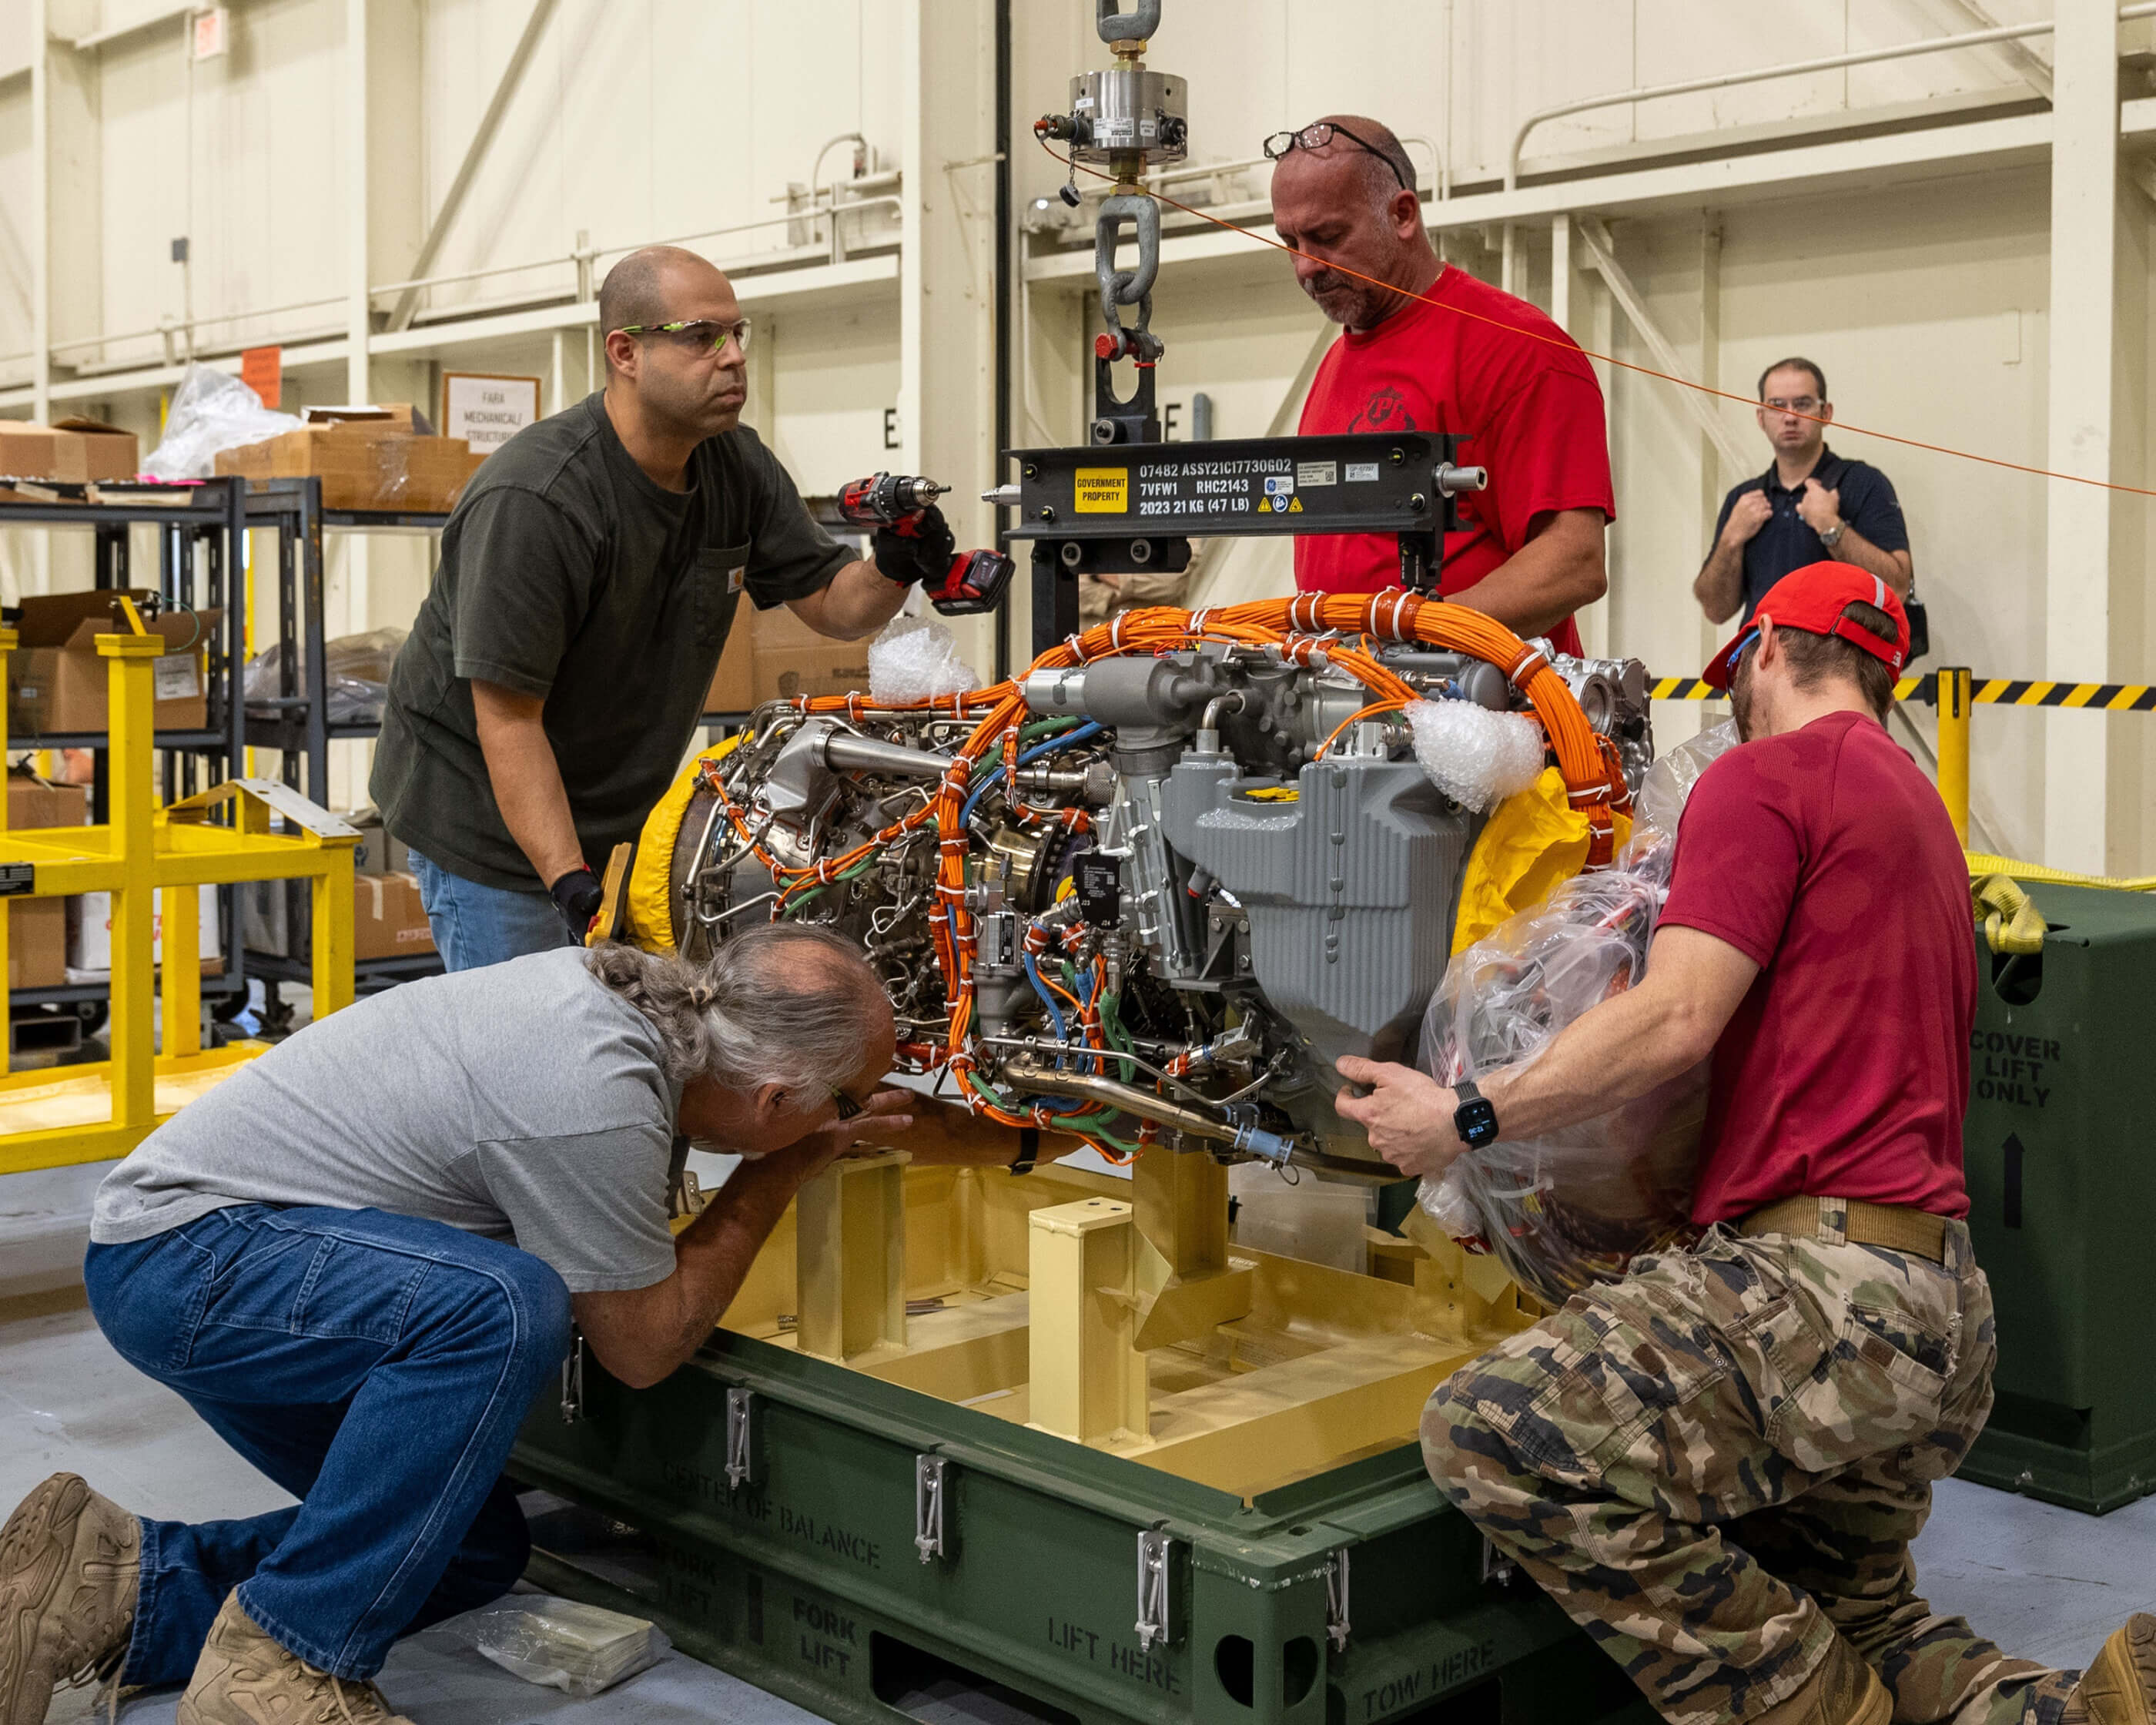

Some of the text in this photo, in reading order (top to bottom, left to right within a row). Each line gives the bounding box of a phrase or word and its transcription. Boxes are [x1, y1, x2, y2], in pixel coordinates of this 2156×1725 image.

[1077, 478, 1125, 487] GOVERNMENT
[1140, 464, 1178, 478] 07482
[1083, 492, 1120, 501] PROPERTY
[1140, 482, 1177, 497] 7VFW1
[1197, 479, 1249, 494] RHC2143
[1140, 497, 1250, 515] 2023 21 KG (47 LB)
[1970, 1030, 2061, 1062] COVER
[1986, 1056, 2044, 1083] LIFT
[1977, 1079, 2051, 1108] ONLY
[663, 1460, 880, 1570] CENTER OF BALANCE
[793, 1596, 857, 1647] FORK
[802, 1634, 851, 1676] LIFT
[1048, 1616, 1181, 1695] LIFT HERE
[1362, 1638, 1494, 1719] TOW HERE
